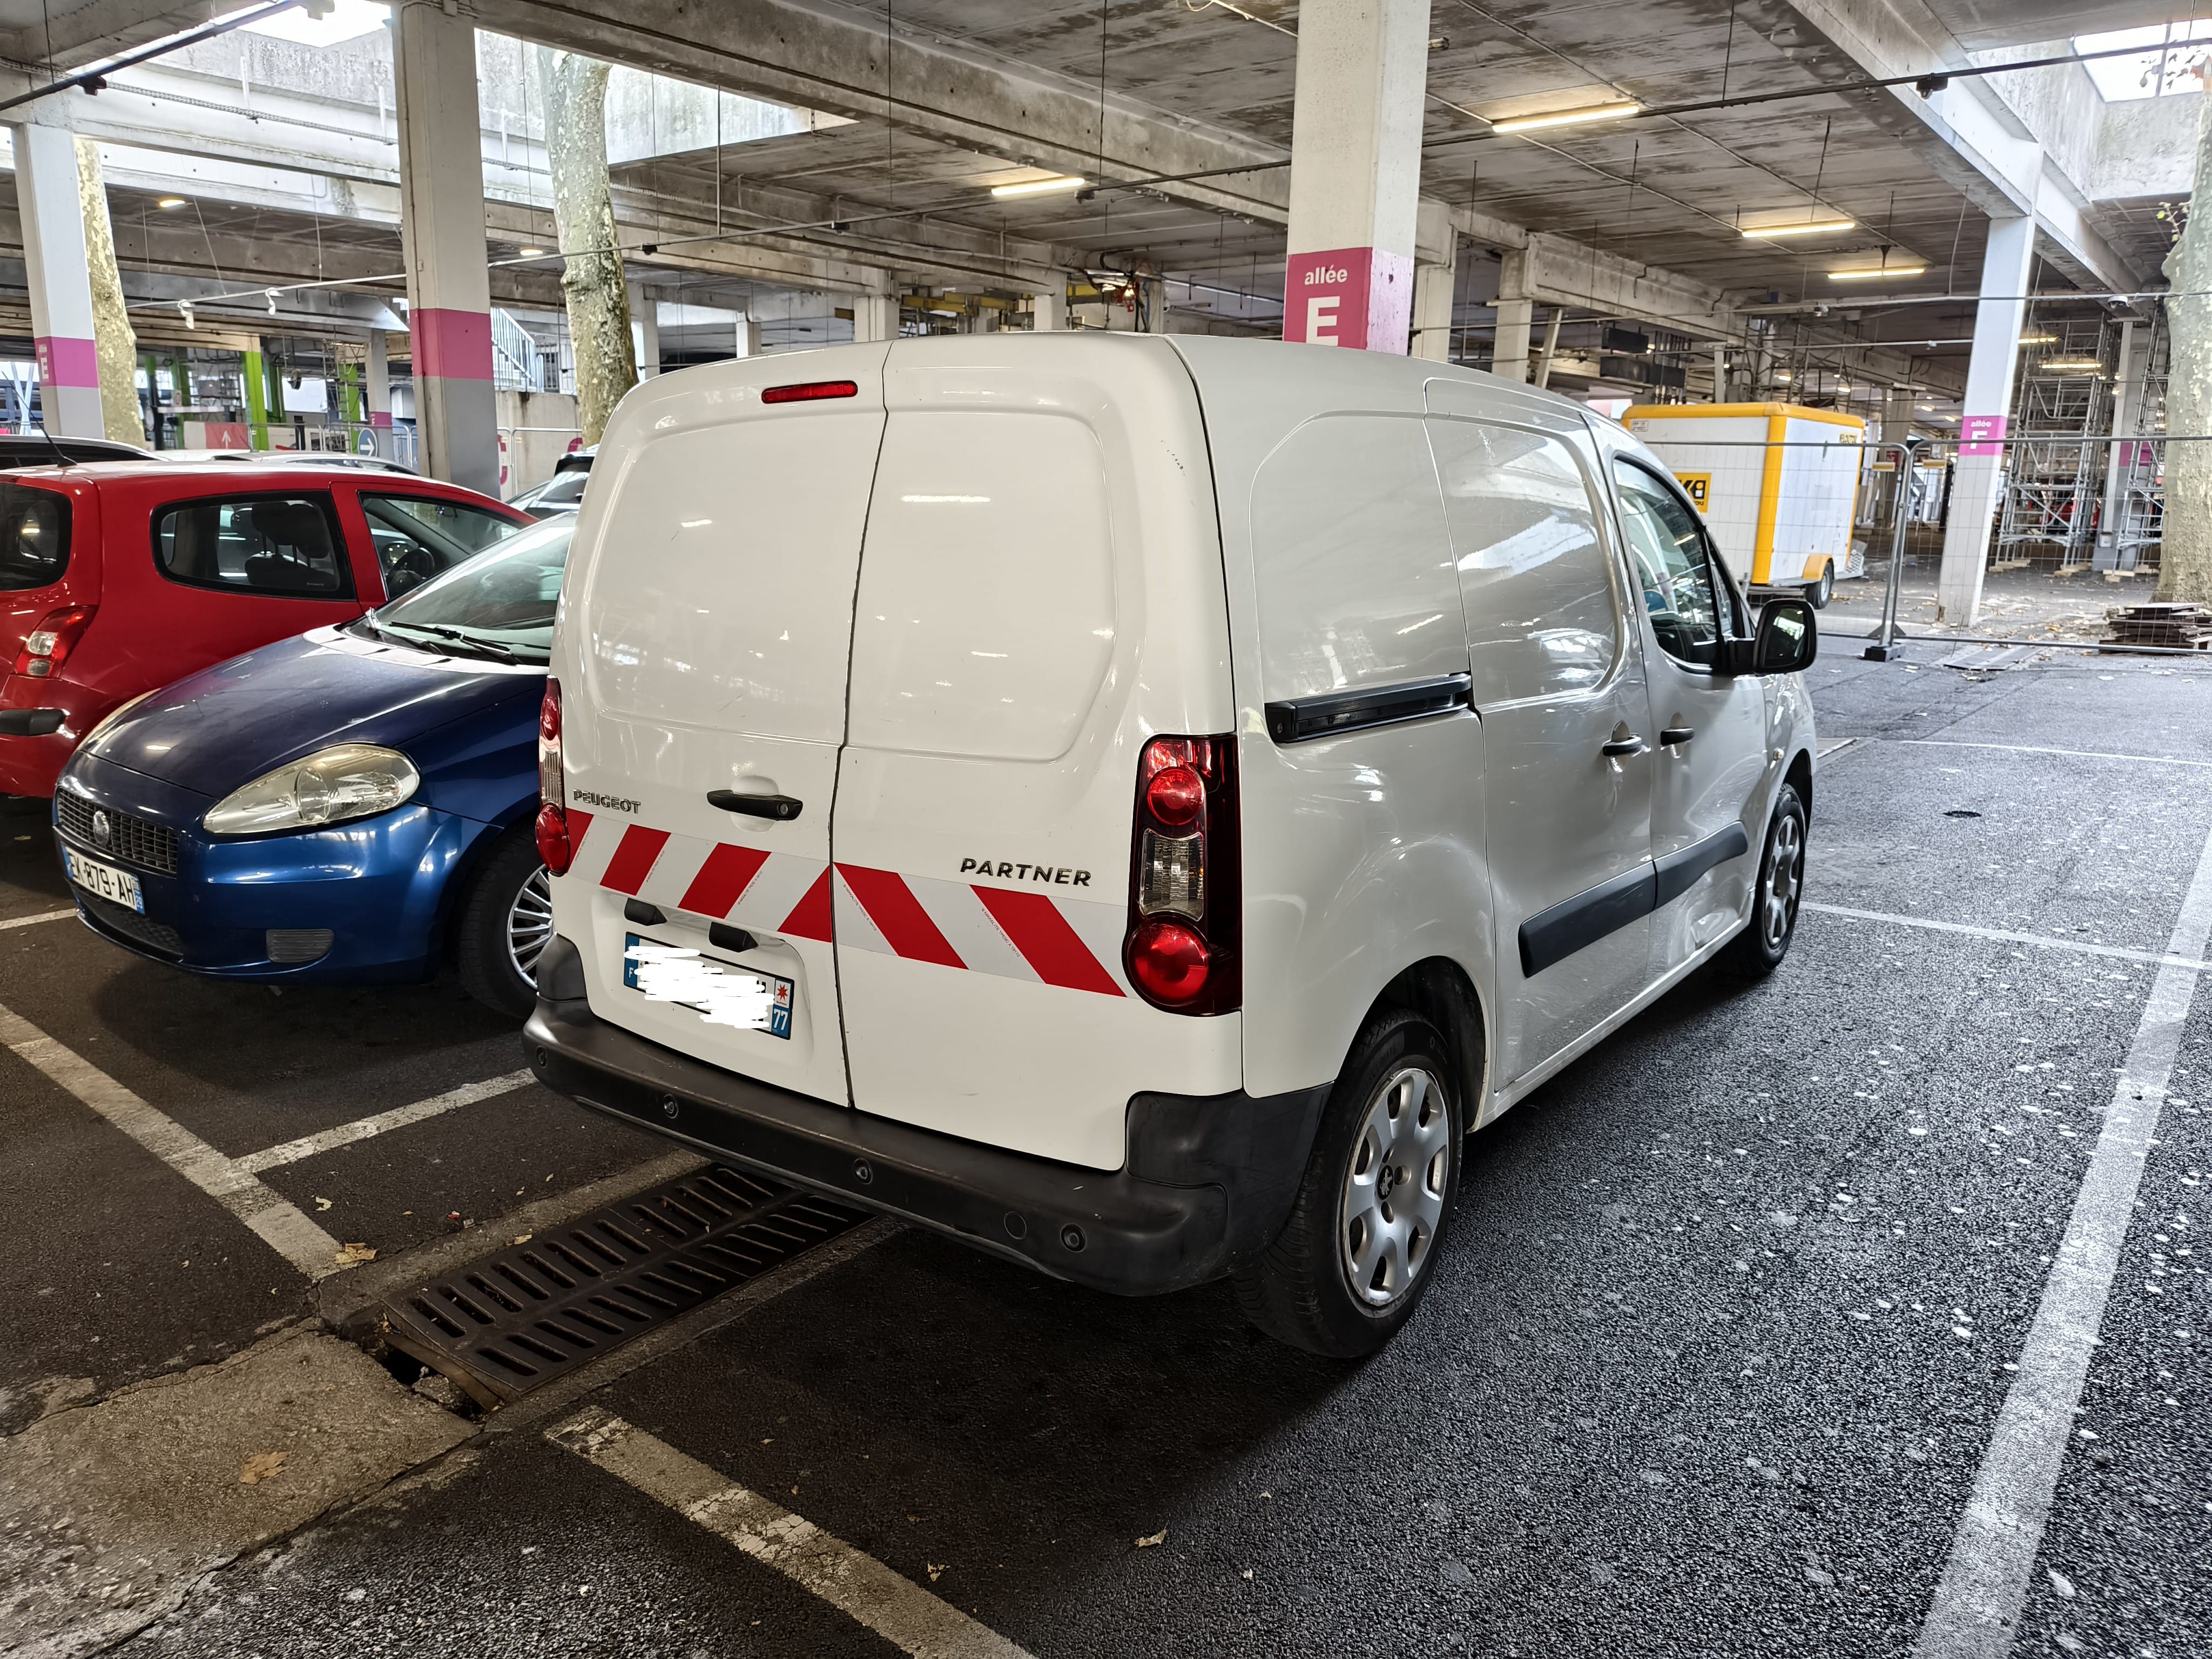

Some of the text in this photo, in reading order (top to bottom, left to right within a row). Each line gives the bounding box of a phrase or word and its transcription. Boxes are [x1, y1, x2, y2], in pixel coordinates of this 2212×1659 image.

[1305, 265, 1348, 285] allée
[1306, 296, 1340, 347] E
[41, 358, 49, 379] E
[573, 788, 642, 814] PEUGEOT
[960, 858, 1091, 887] PARTNER
[629, 967, 634, 978] F
[773, 1008, 788, 1030] 77
